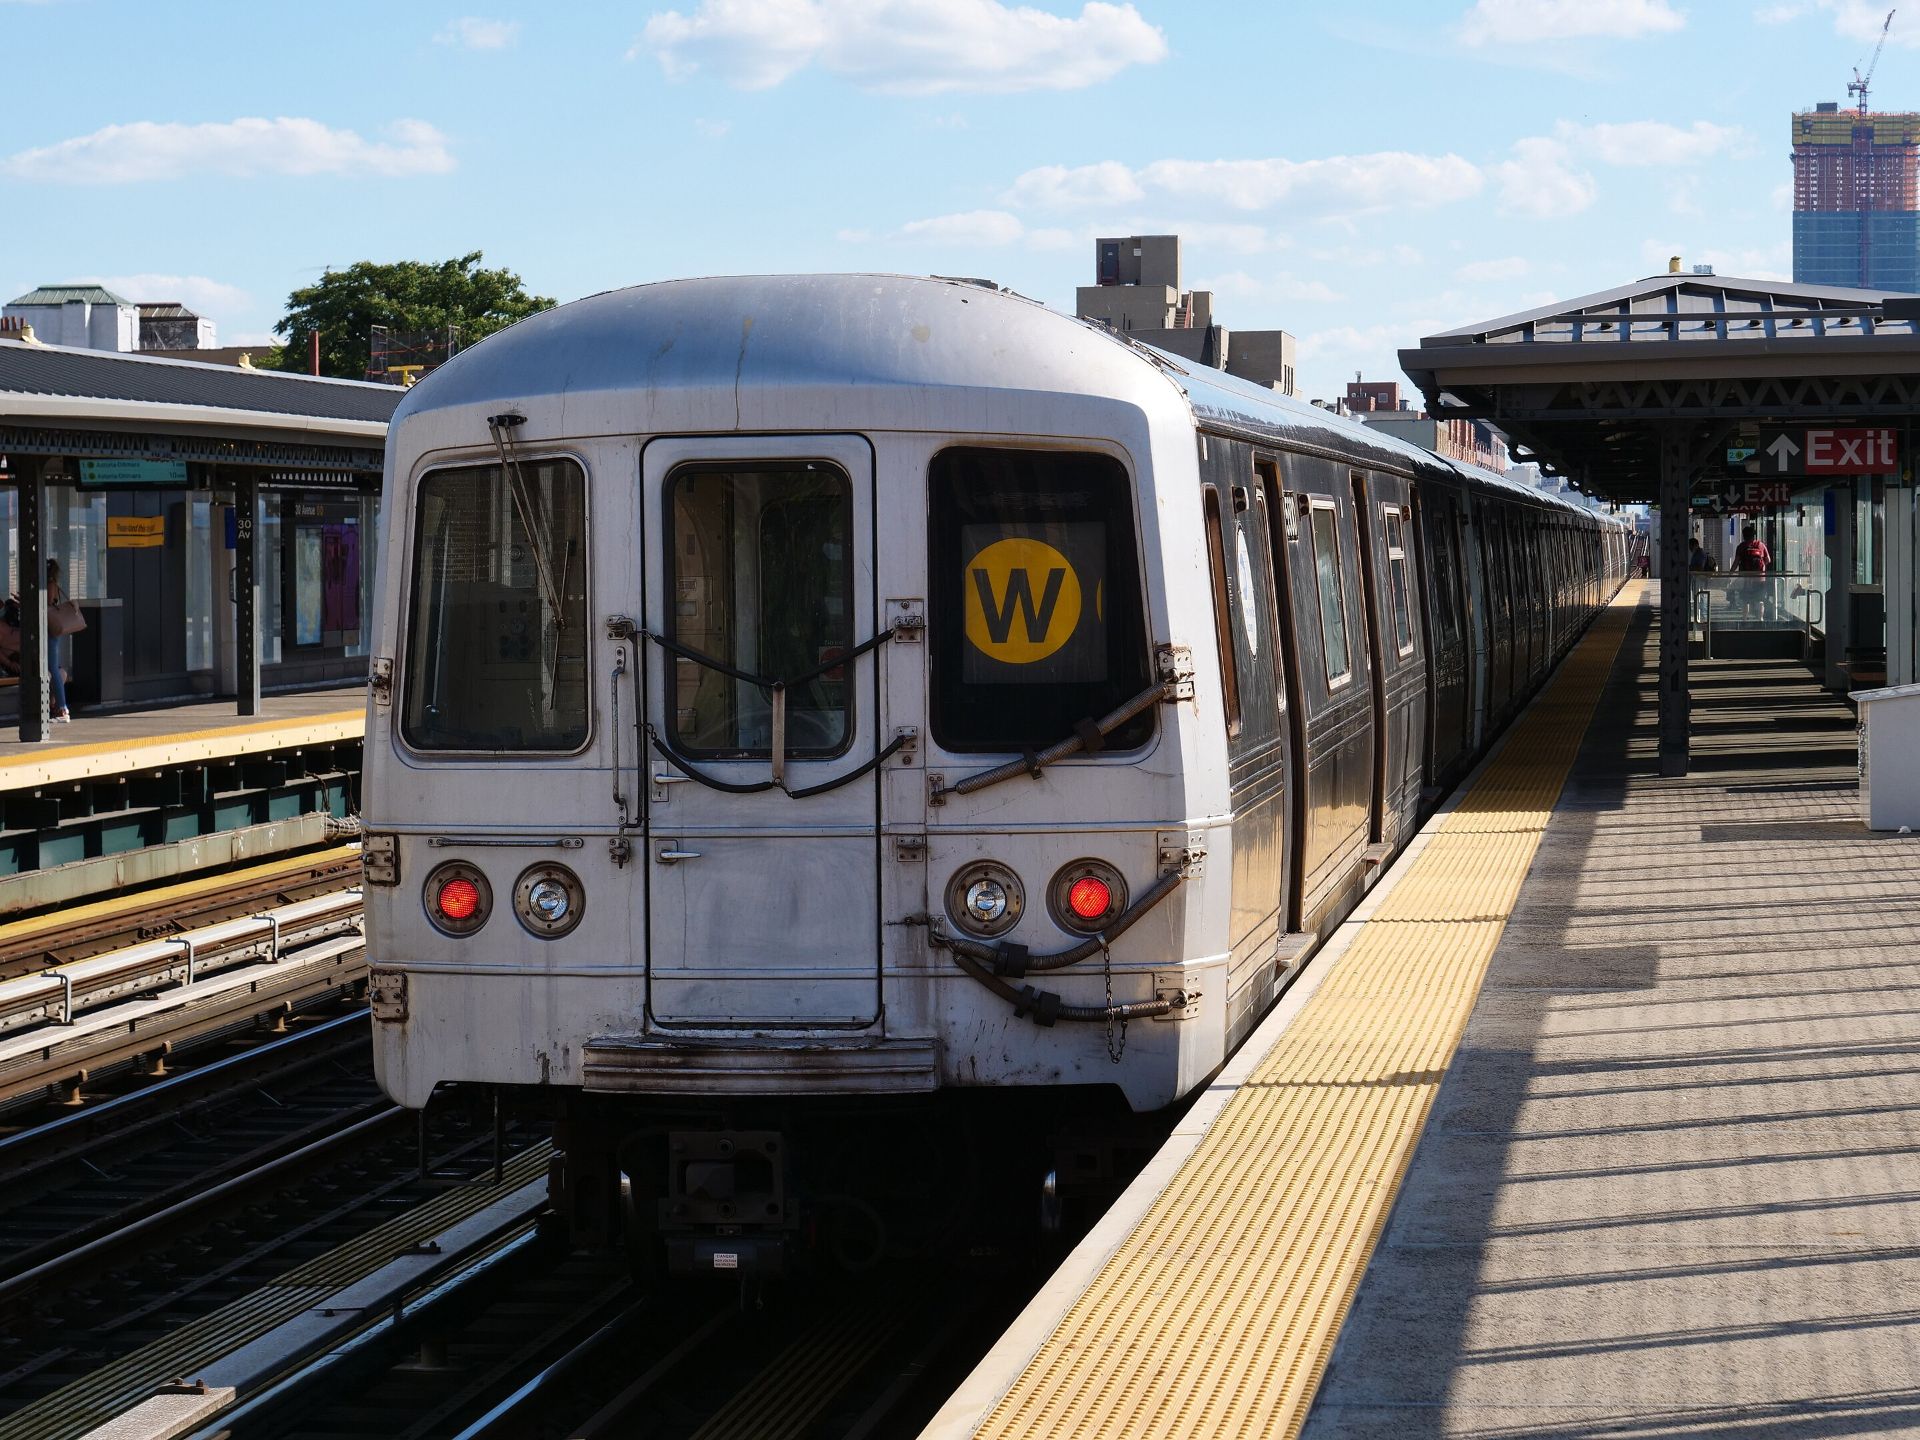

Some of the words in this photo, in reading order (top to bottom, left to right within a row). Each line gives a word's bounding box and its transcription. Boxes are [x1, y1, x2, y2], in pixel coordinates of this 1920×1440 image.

[1806, 430, 1894, 466] Exit
[1744, 483, 1790, 503] Exit
[237, 519, 252, 529] 30
[237, 530, 251, 539] Av
[972, 567, 1067, 644] W
